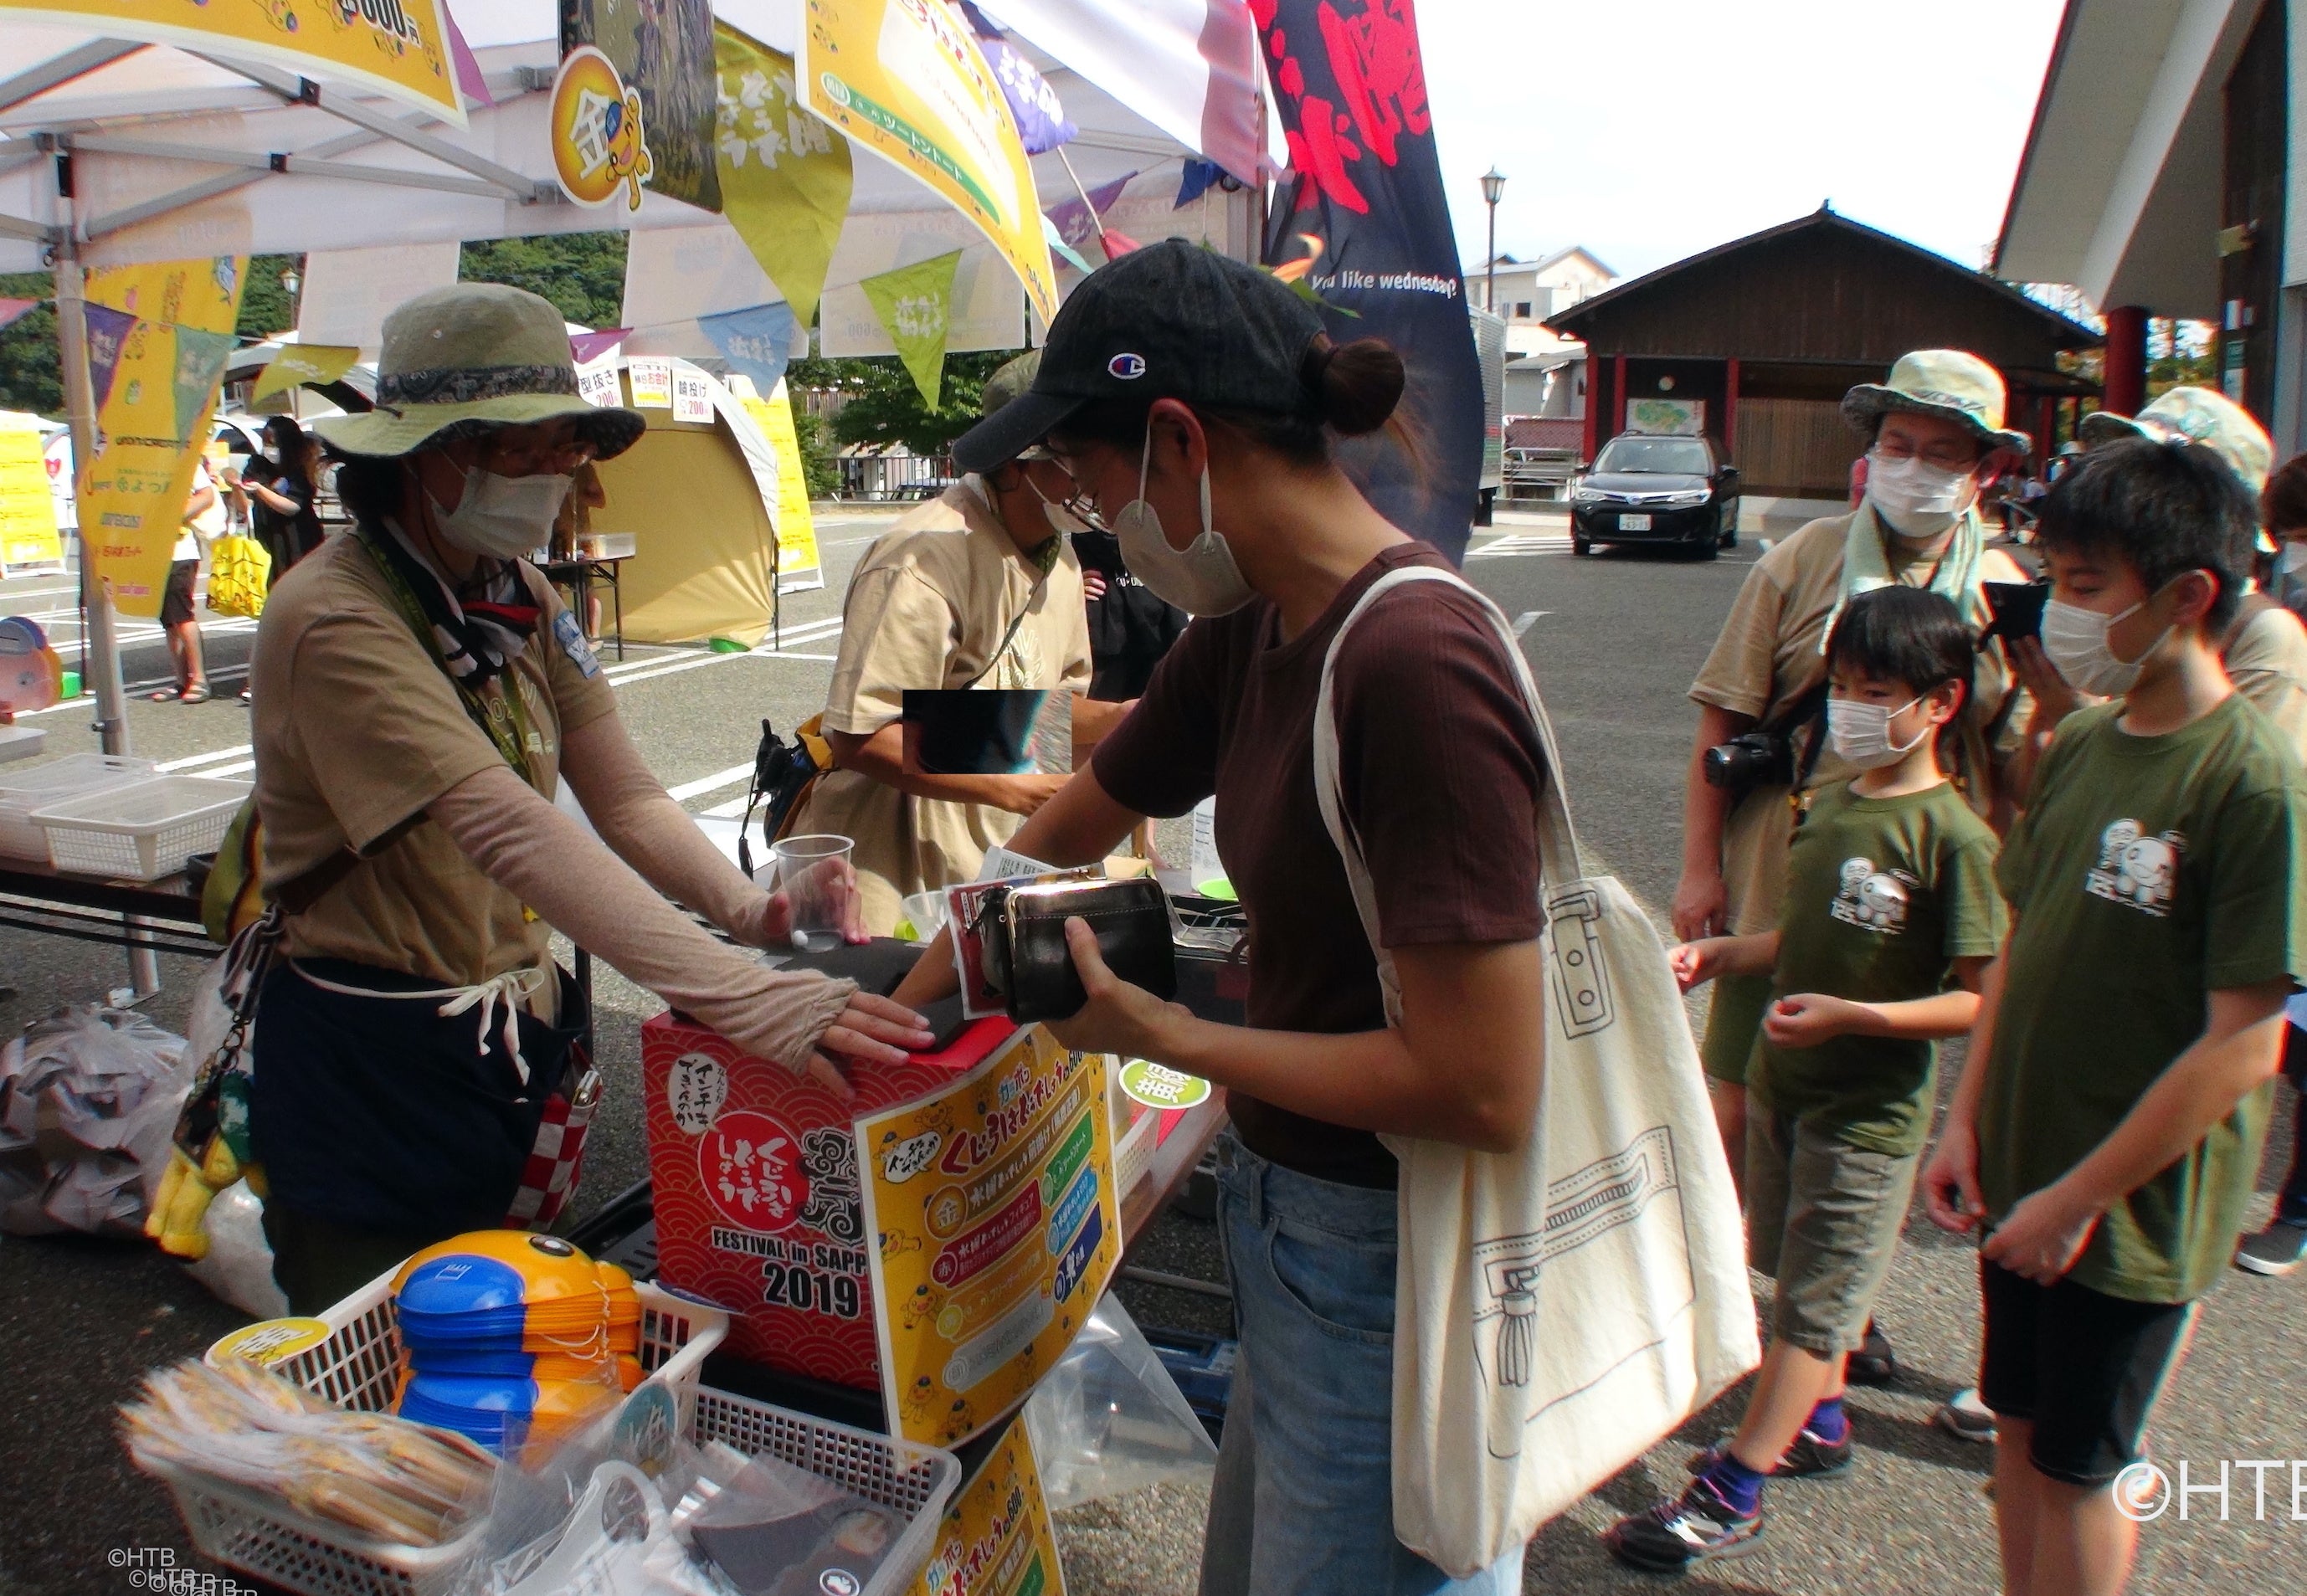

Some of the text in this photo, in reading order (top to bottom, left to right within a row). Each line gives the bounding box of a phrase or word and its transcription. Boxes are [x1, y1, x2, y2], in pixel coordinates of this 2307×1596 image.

[569, 88, 609, 180] 金
[1341, 269, 1374, 290] like
[579, 368, 615, 395] 型抜き
[694, 1063, 713, 1126] インチキ
[935, 1198, 961, 1229] 金
[712, 1227, 867, 1275] FESTIVAL in SAPP
[763, 1260, 861, 1319] 2019
